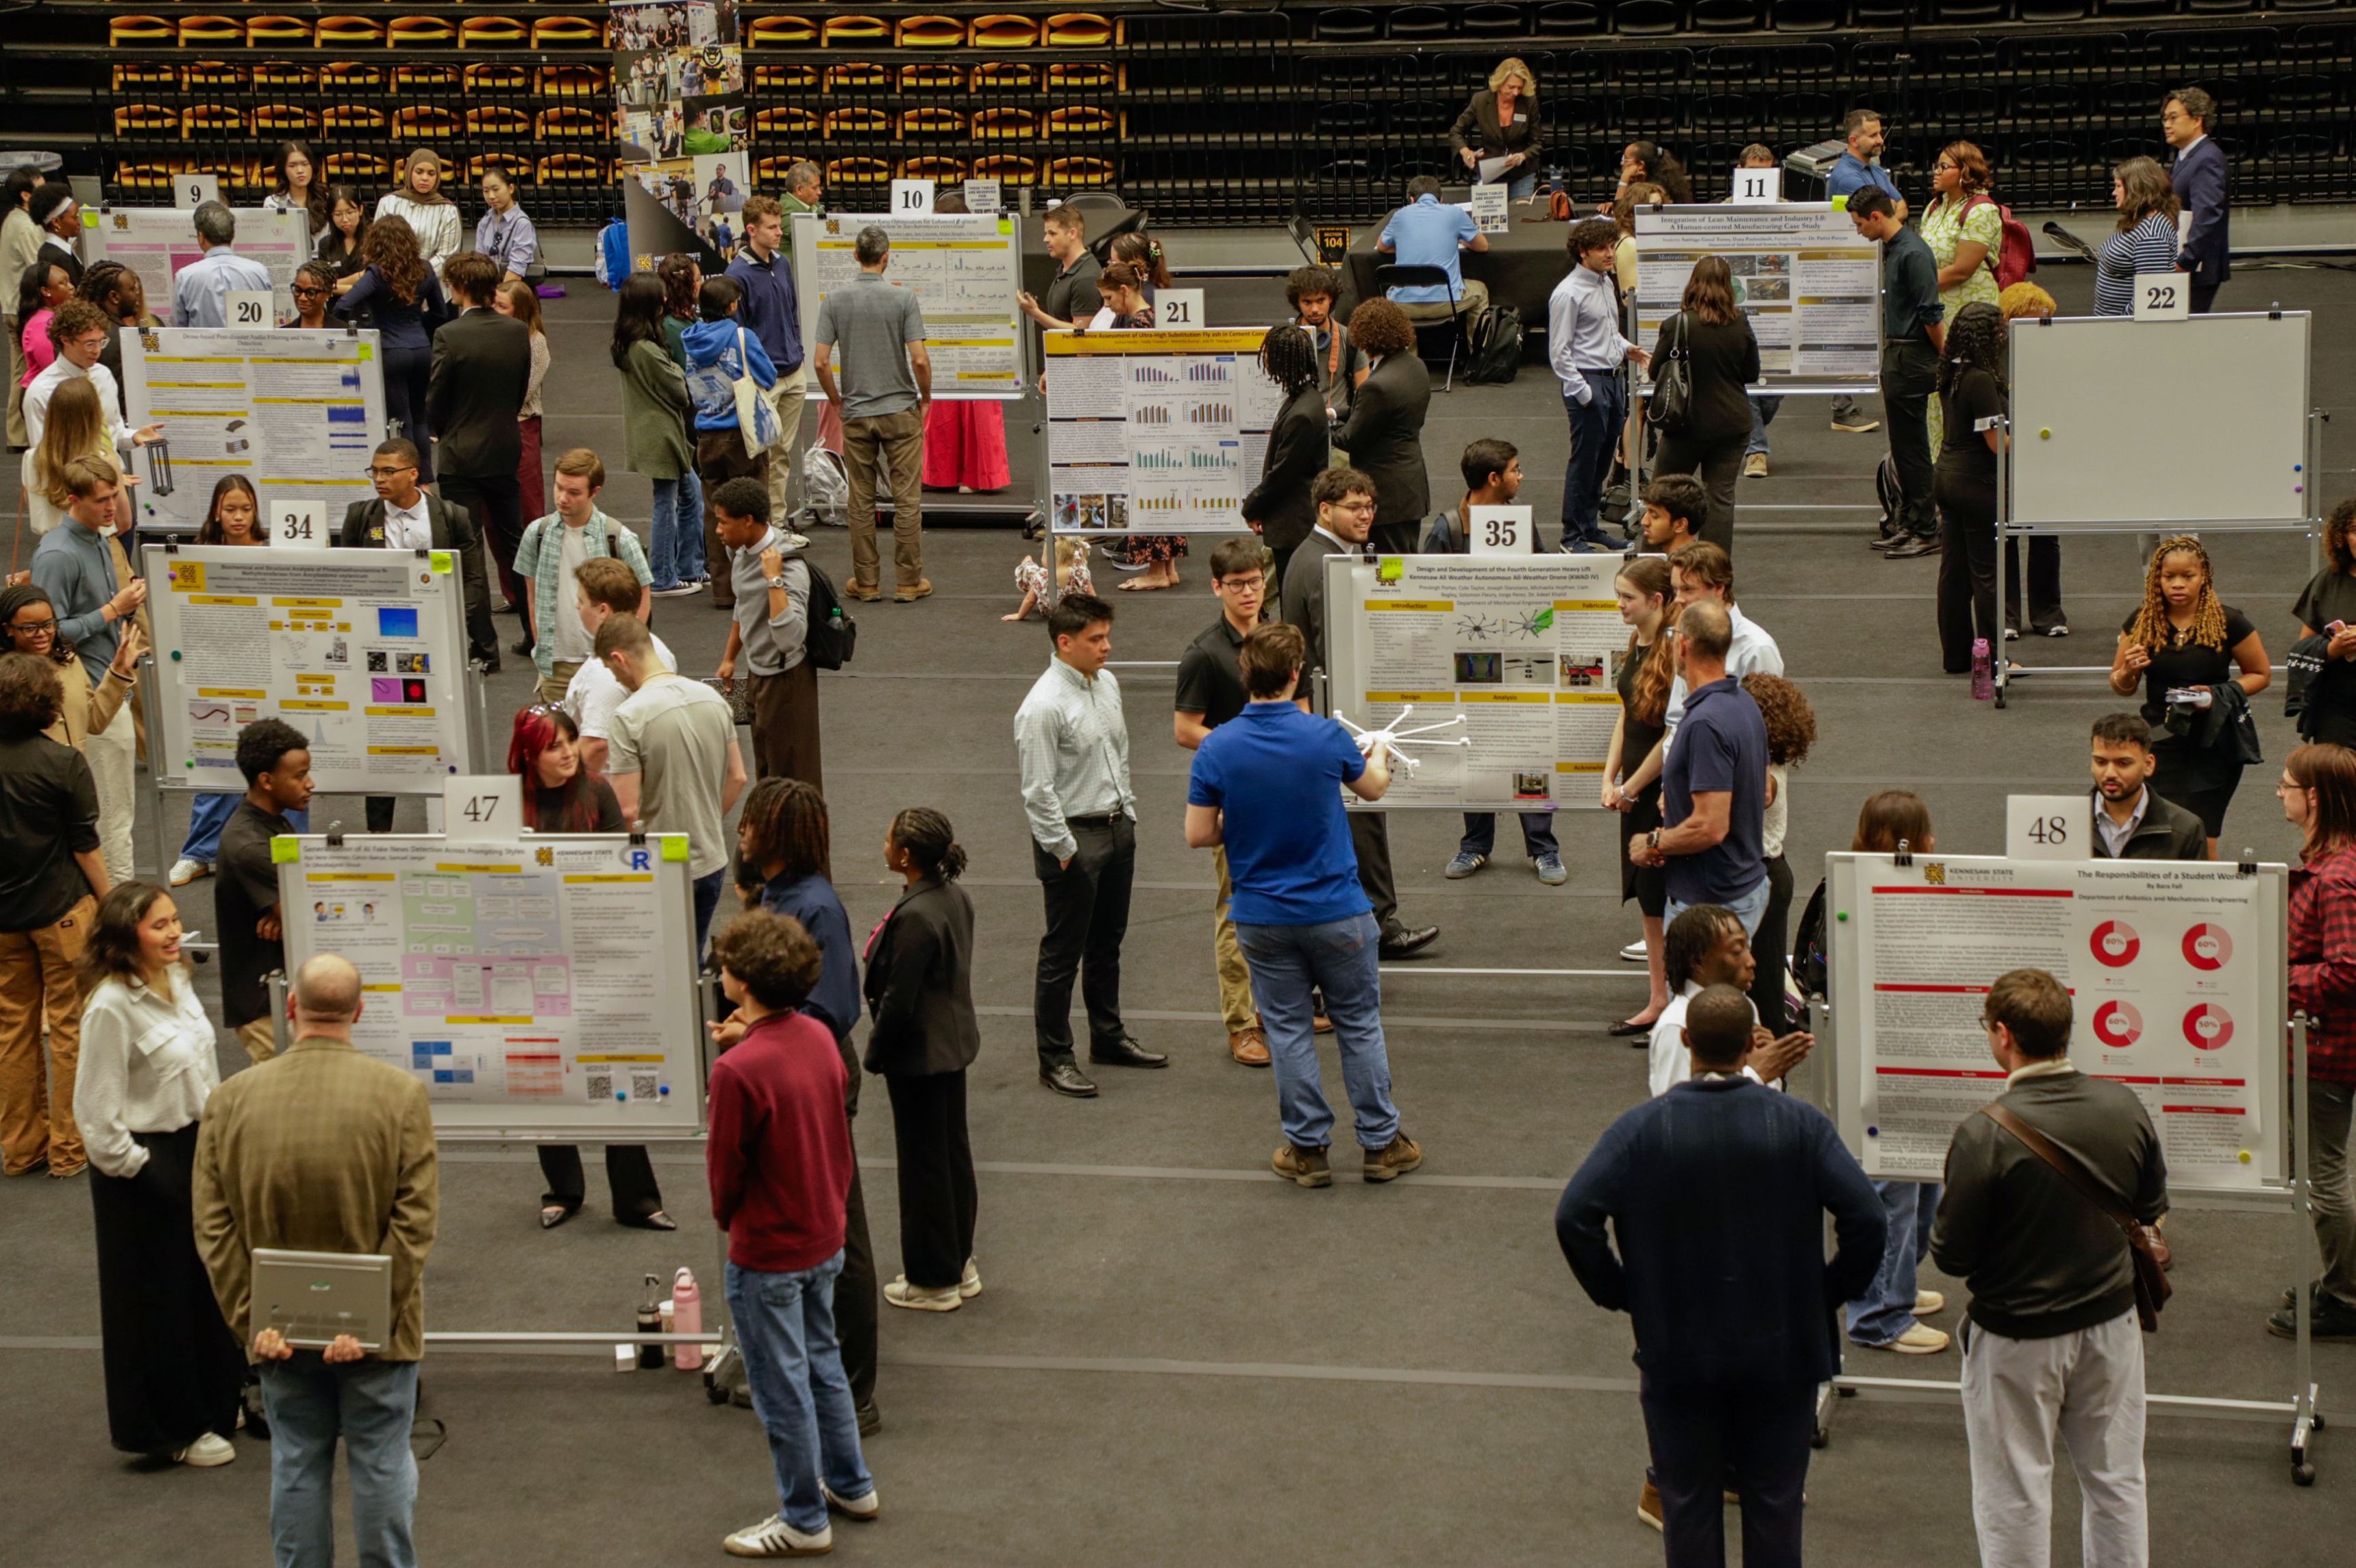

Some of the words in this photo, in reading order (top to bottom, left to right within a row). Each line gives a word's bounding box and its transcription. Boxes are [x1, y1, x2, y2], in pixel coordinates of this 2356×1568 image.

[190, 185, 201, 203] 9
[1744, 178, 1766, 197] 11
[902, 190, 922, 209] 10
[1733, 223, 1783, 232] Manufacturing
[1801, 223, 1820, 231] Study
[1784, 215, 1813, 223] Industry
[1324, 237, 1343, 248] 104
[2147, 286, 2176, 310] 22
[237, 301, 262, 323] 20
[1166, 301, 1191, 323] 21
[1140, 332, 1167, 340] Ultra-High
[284, 514, 312, 539] 34
[1485, 521, 1517, 547] 35
[1400, 694, 1421, 702] Design
[463, 796, 499, 822] 47
[2028, 815, 2066, 845] 48
[467, 847, 503, 856] Prompting
[504, 848, 525, 856] Styles
[631, 851, 651, 871] R
[1992, 869, 2013, 877] STATE
[2077, 870, 2093, 879] The
[2094, 871, 2161, 882] Responsibilities
[2162, 871, 2172, 880] of
[2181, 871, 2215, 880] Student
[2216, 871, 2248, 881] Worker
[2146, 882, 2155, 891] By
[2079, 893, 2116, 903] Department
[2210, 895, 2248, 905] Engineering
